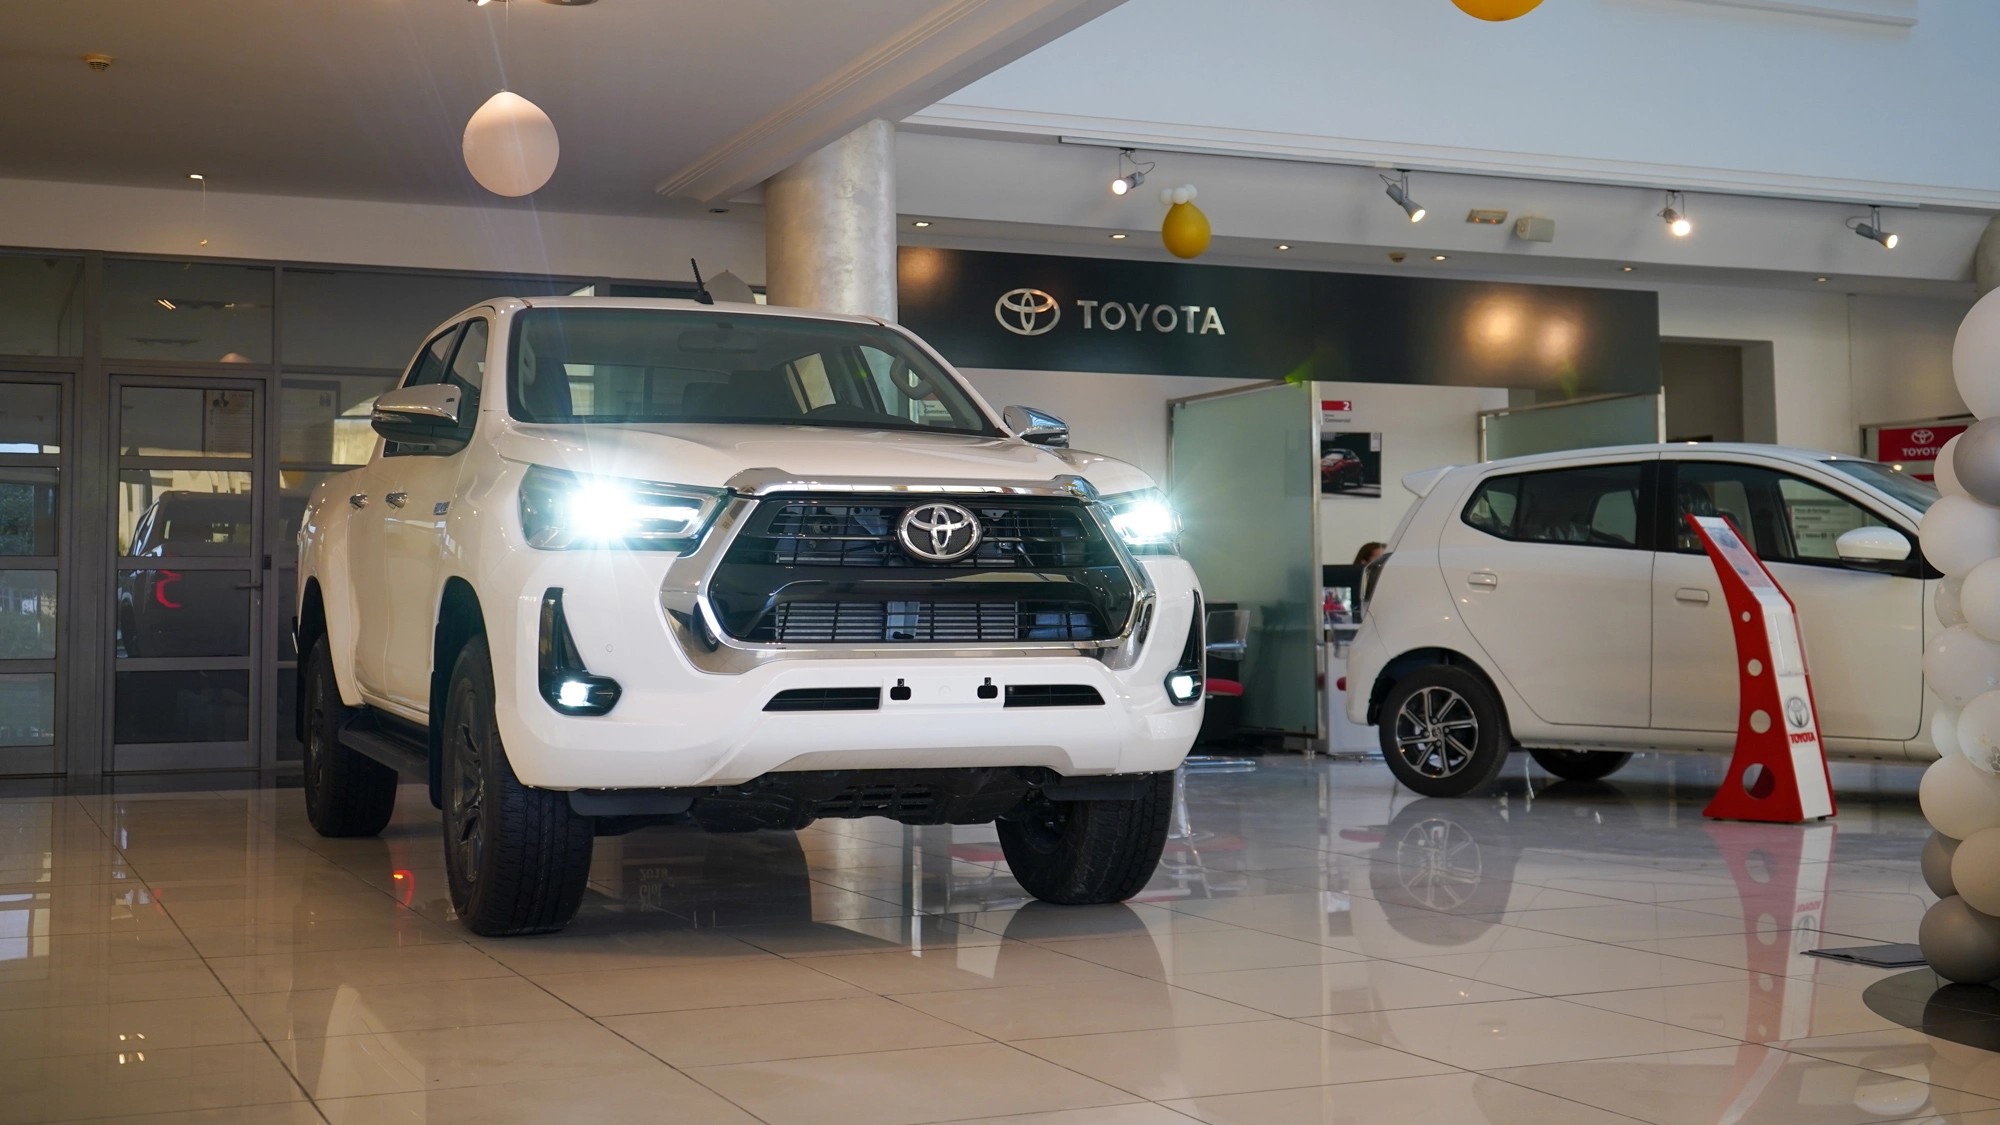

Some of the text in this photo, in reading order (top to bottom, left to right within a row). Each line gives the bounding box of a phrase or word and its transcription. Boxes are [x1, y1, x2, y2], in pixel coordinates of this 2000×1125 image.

[1077, 300, 1226, 335] TOYOTA
[1344, 401, 1350, 411] 2
[1790, 732, 1816, 744] TOYOTA
